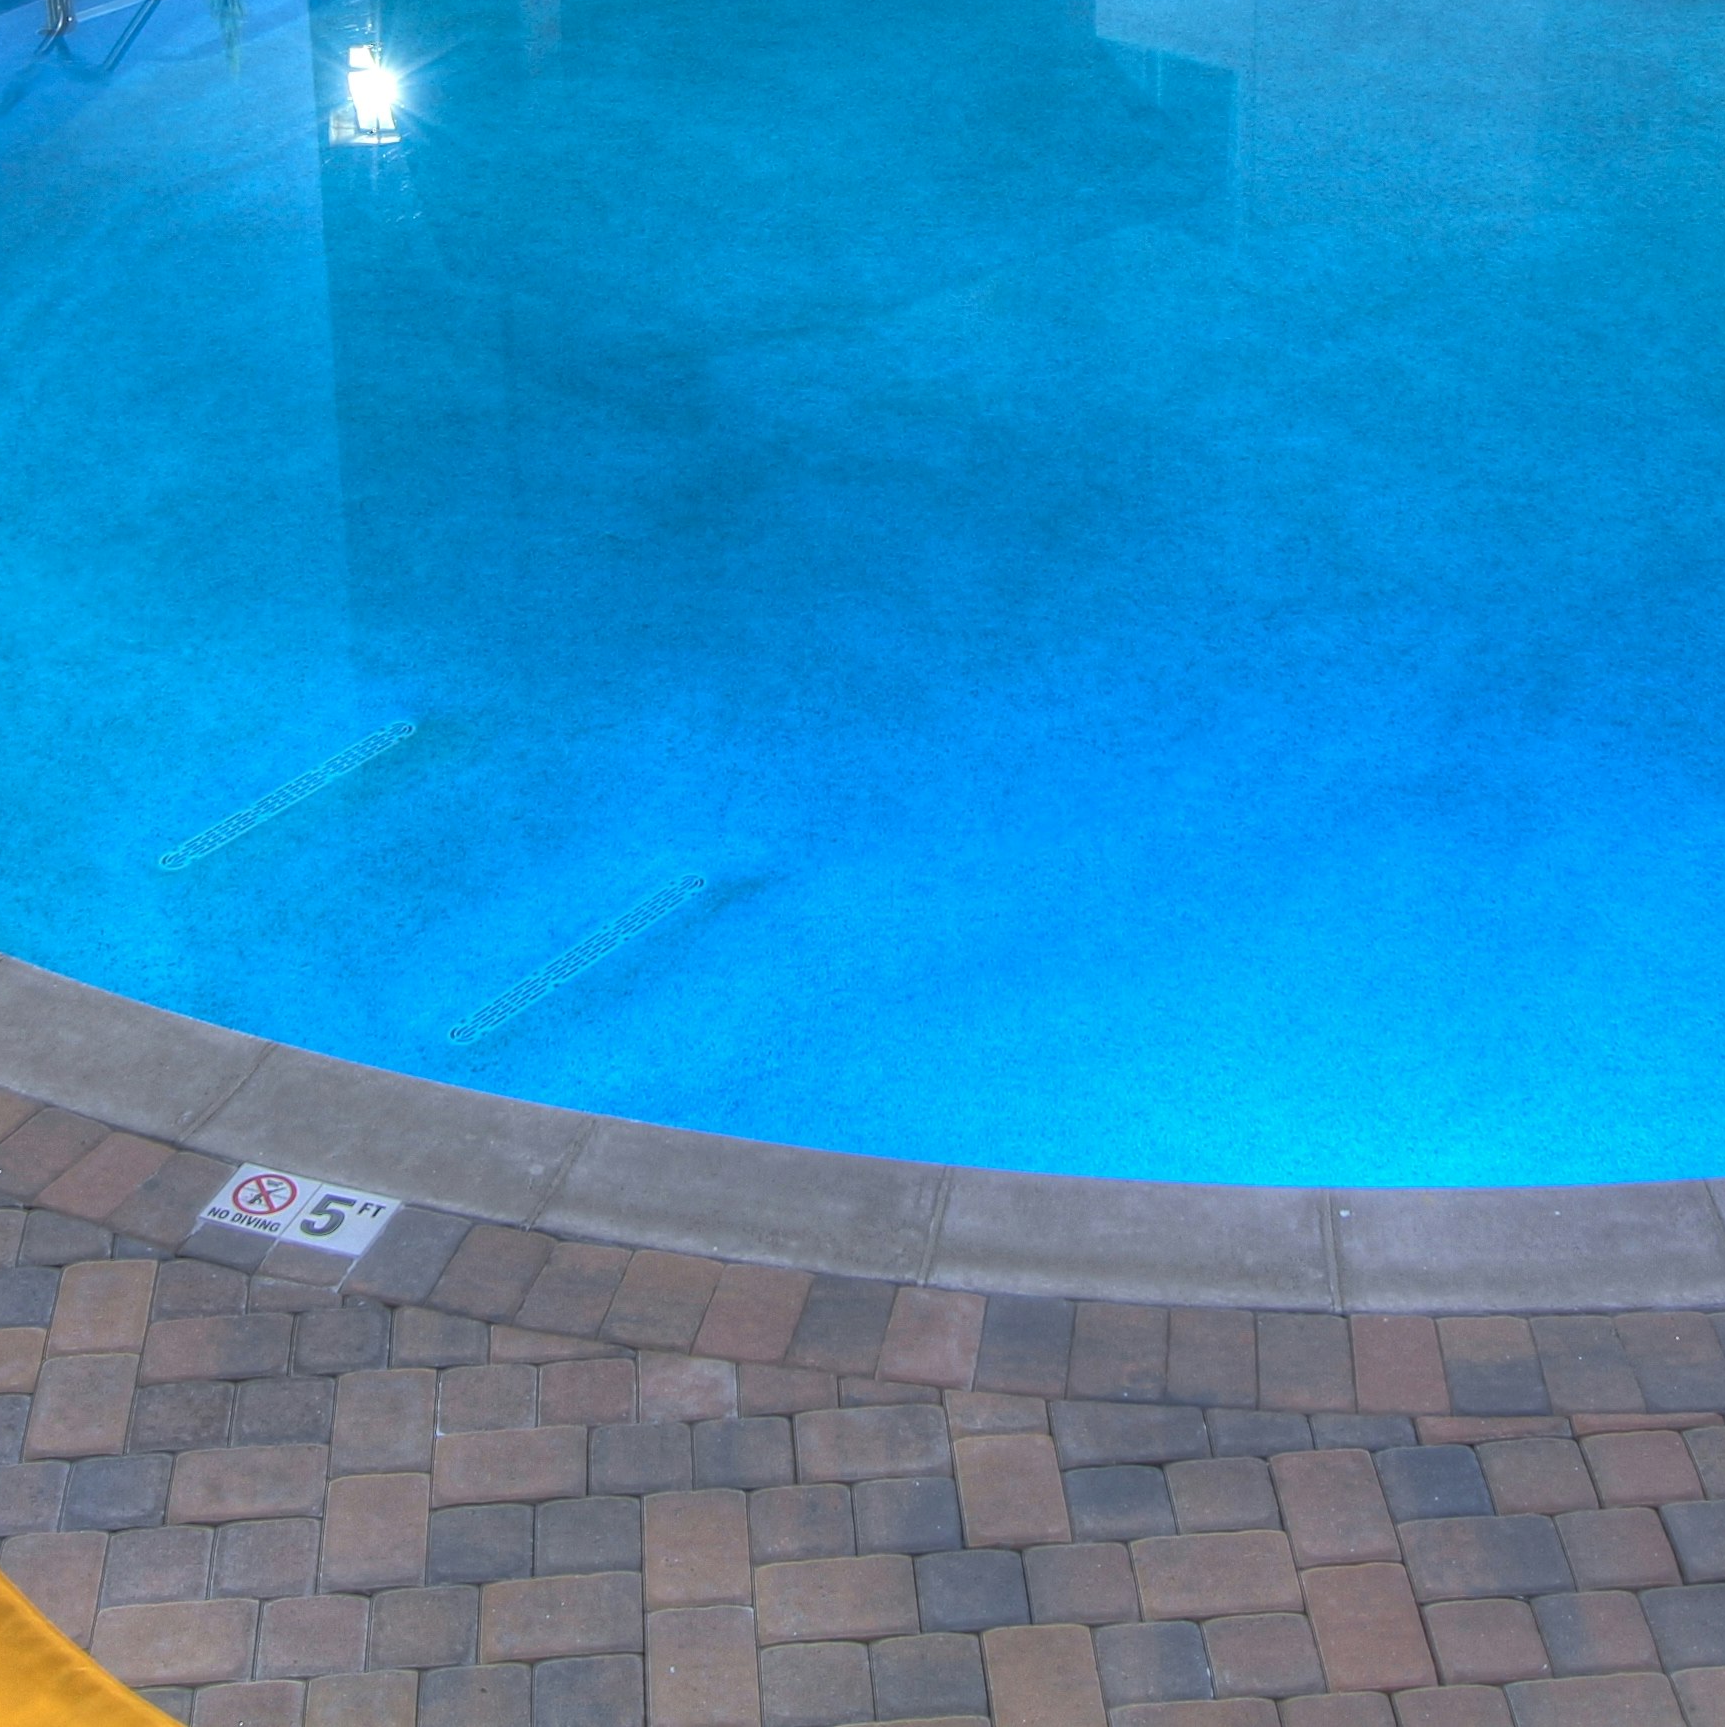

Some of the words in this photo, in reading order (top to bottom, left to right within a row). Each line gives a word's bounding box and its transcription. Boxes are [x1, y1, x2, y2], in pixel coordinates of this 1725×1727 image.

[207, 1206, 230, 1220] NO
[232, 1213, 282, 1233] DIVING
[300, 1193, 357, 1237] 5
[357, 1202, 387, 1219] FT
